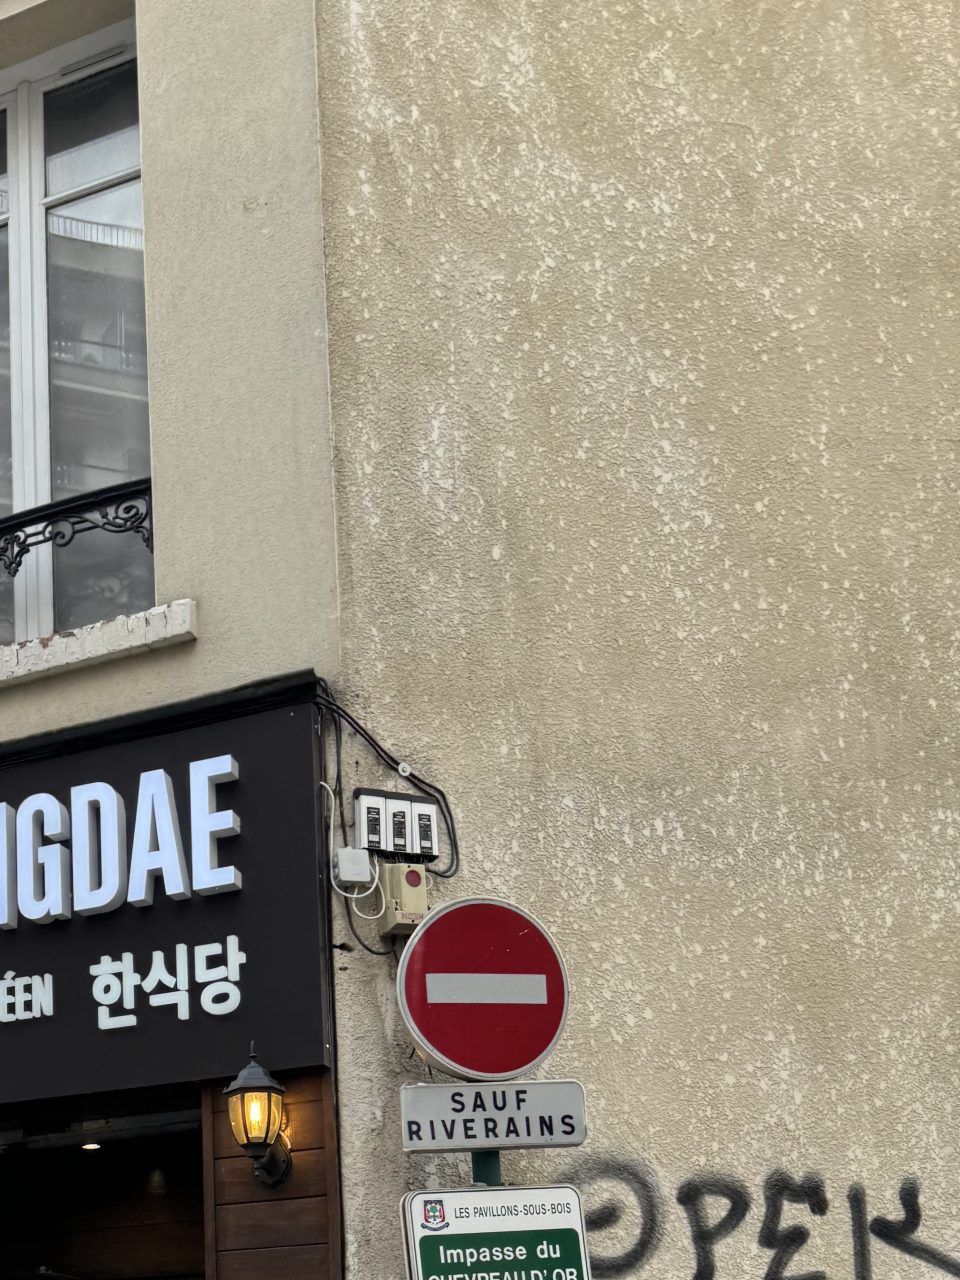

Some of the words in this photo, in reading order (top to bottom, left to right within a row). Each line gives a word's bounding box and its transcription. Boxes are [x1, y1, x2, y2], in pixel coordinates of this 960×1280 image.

[89, 935, 246, 1031] 한식당
[451, 1089, 528, 1113] SAUF
[407, 1114, 576, 1142] RIVERAINS
[454, 1207, 470, 1219] LES
[473, 1202, 572, 1218] PAVILLONS-SOUS-BOIS
[439, 1244, 527, 1267] Impasse
[536, 1240, 561, 1259] du
